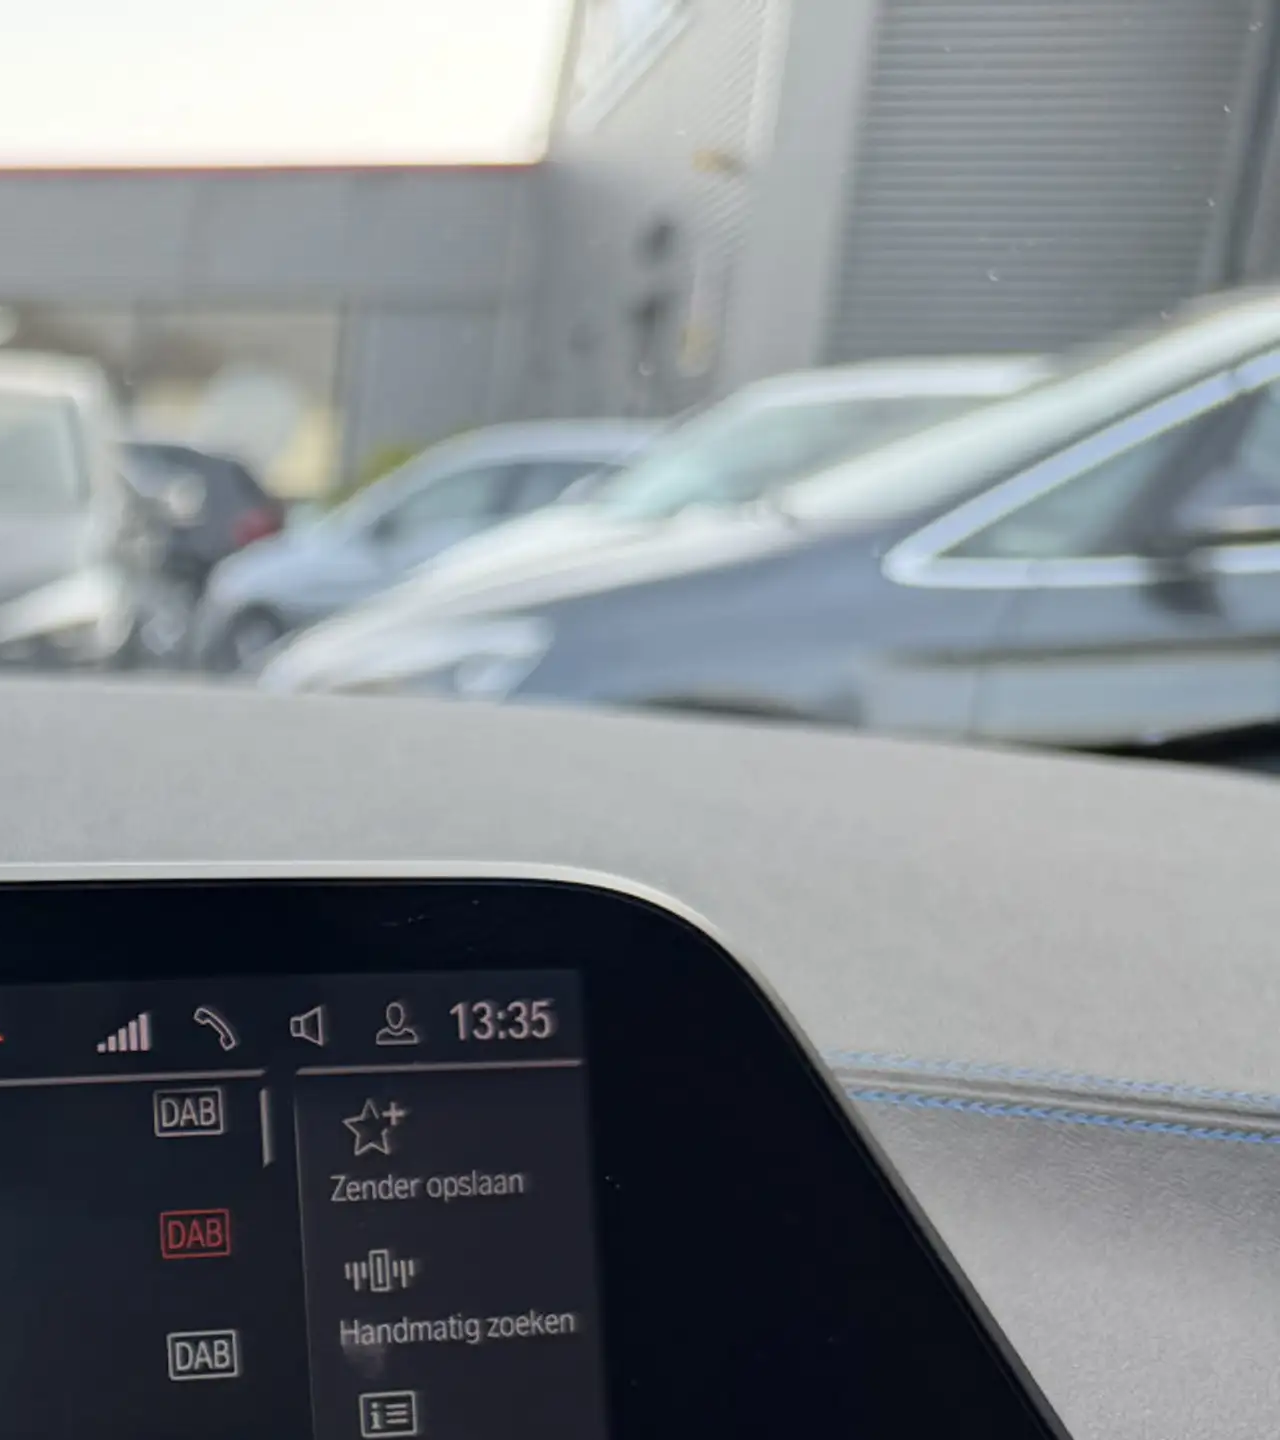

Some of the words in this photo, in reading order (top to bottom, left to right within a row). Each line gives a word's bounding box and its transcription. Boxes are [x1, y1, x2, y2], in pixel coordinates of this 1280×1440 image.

[450, 1000, 552, 1040] 13:35
[159, 1098, 217, 1128] DAB
[331, 1174, 420, 1201] Zender
[427, 1170, 524, 1203] opslaan
[166, 1218, 224, 1250] DAB
[340, 1316, 480, 1346] Handmatig
[487, 1310, 574, 1337] zoeken
[174, 1339, 231, 1372] DAB
